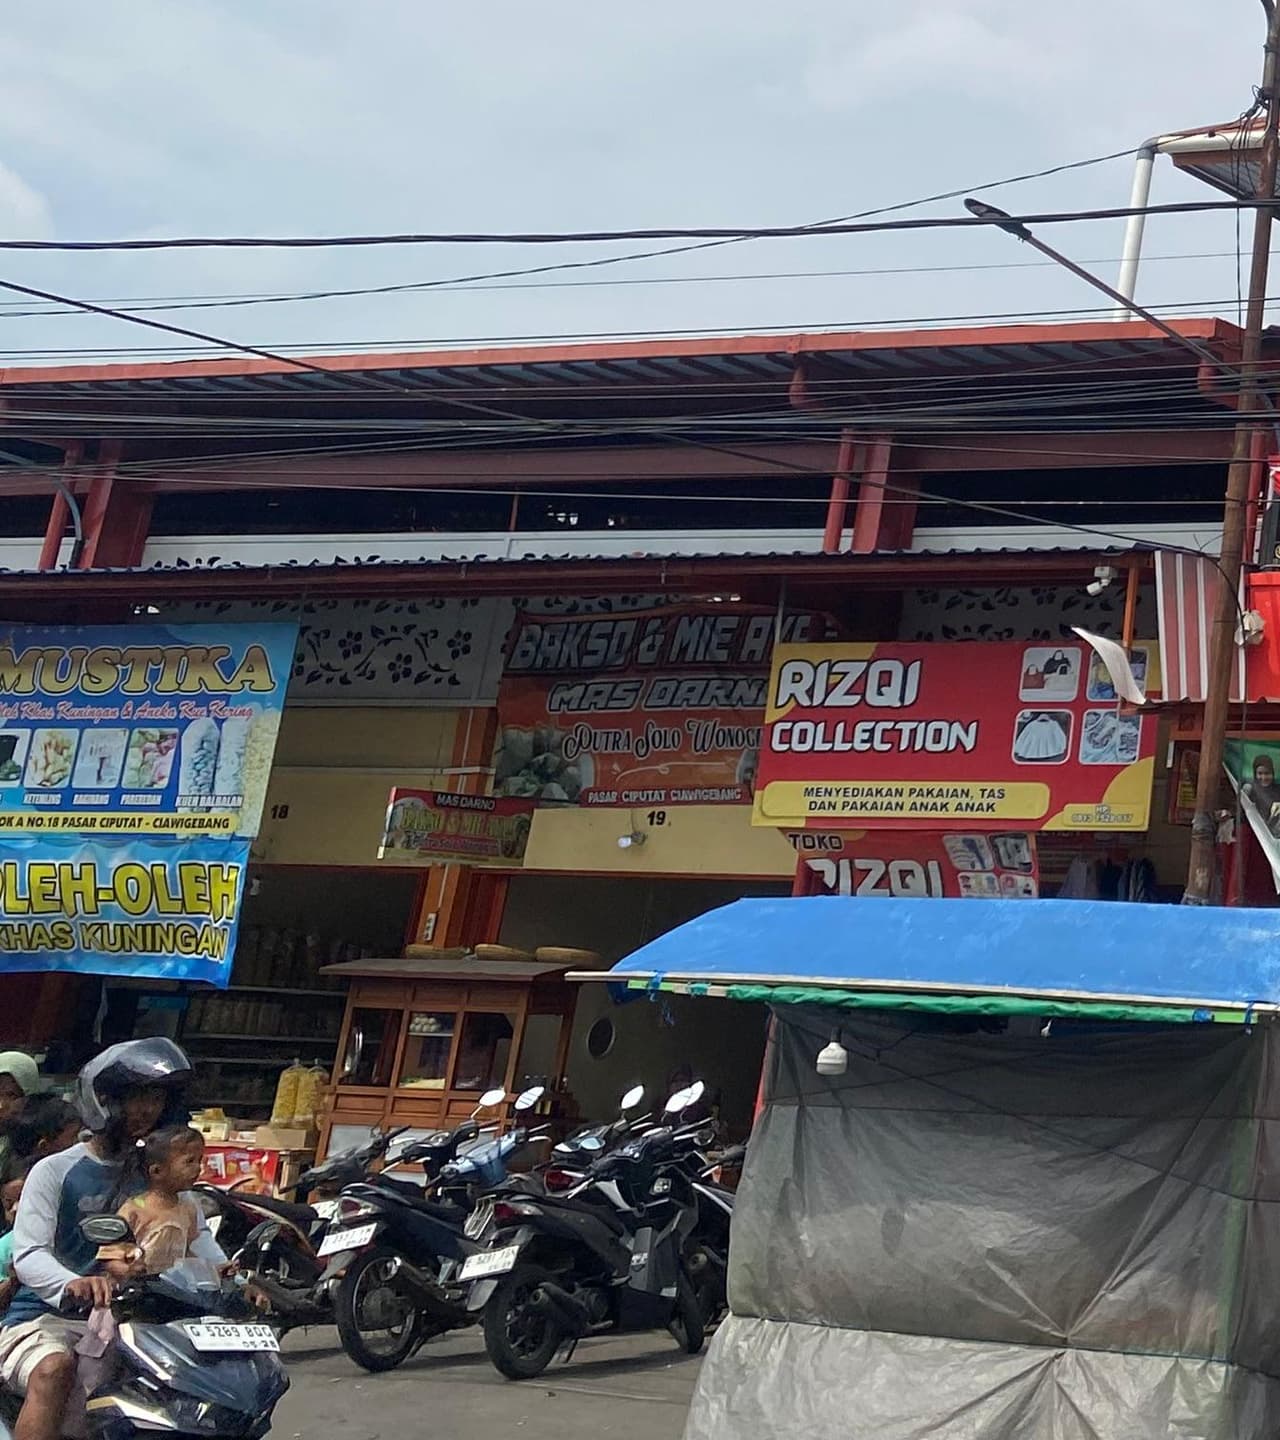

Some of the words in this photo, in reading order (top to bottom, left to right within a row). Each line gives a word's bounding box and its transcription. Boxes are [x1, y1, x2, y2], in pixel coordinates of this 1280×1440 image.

[507, 620, 638, 671] BAKSO
[668, 615, 740, 663] MIE
[0, 645, 277, 694] MUSTIKA
[549, 679, 645, 711] MAS
[775, 659, 922, 709] RIZQI
[56, 701, 118, 724] Kuningan
[562, 721, 631, 760] PUTRA
[770, 720, 980, 754] COLLECTION
[437, 794, 460, 807] MAS
[460, 796, 496, 811] DARNO
[588, 791, 618, 804] PASAR
[622, 789, 667, 803] CIPUTAT
[803, 786, 903, 799] MENYEDIAKAN
[909, 787, 974, 801] PAKAIAN,
[979, 788, 1006, 800] TAS
[271, 804, 288, 819] 18
[808, 801, 837, 811] DAN
[841, 801, 904, 812] PAKAIAN
[909, 801, 949, 812] ANAK
[954, 802, 996, 813] ANAK
[15, 816, 24, 828] A
[26, 816, 60, 828] NO.18
[61, 816, 97, 828] PASAR
[100, 816, 143, 828] CIPUTAT
[152, 817, 229, 830] CIAWIGEBANG
[646, 811, 667, 827] 19
[788, 833, 843, 851] TOKO
[0, 862, 240, 923] LEH-OLEH
[80, 921, 229, 962] KUNINGAN
